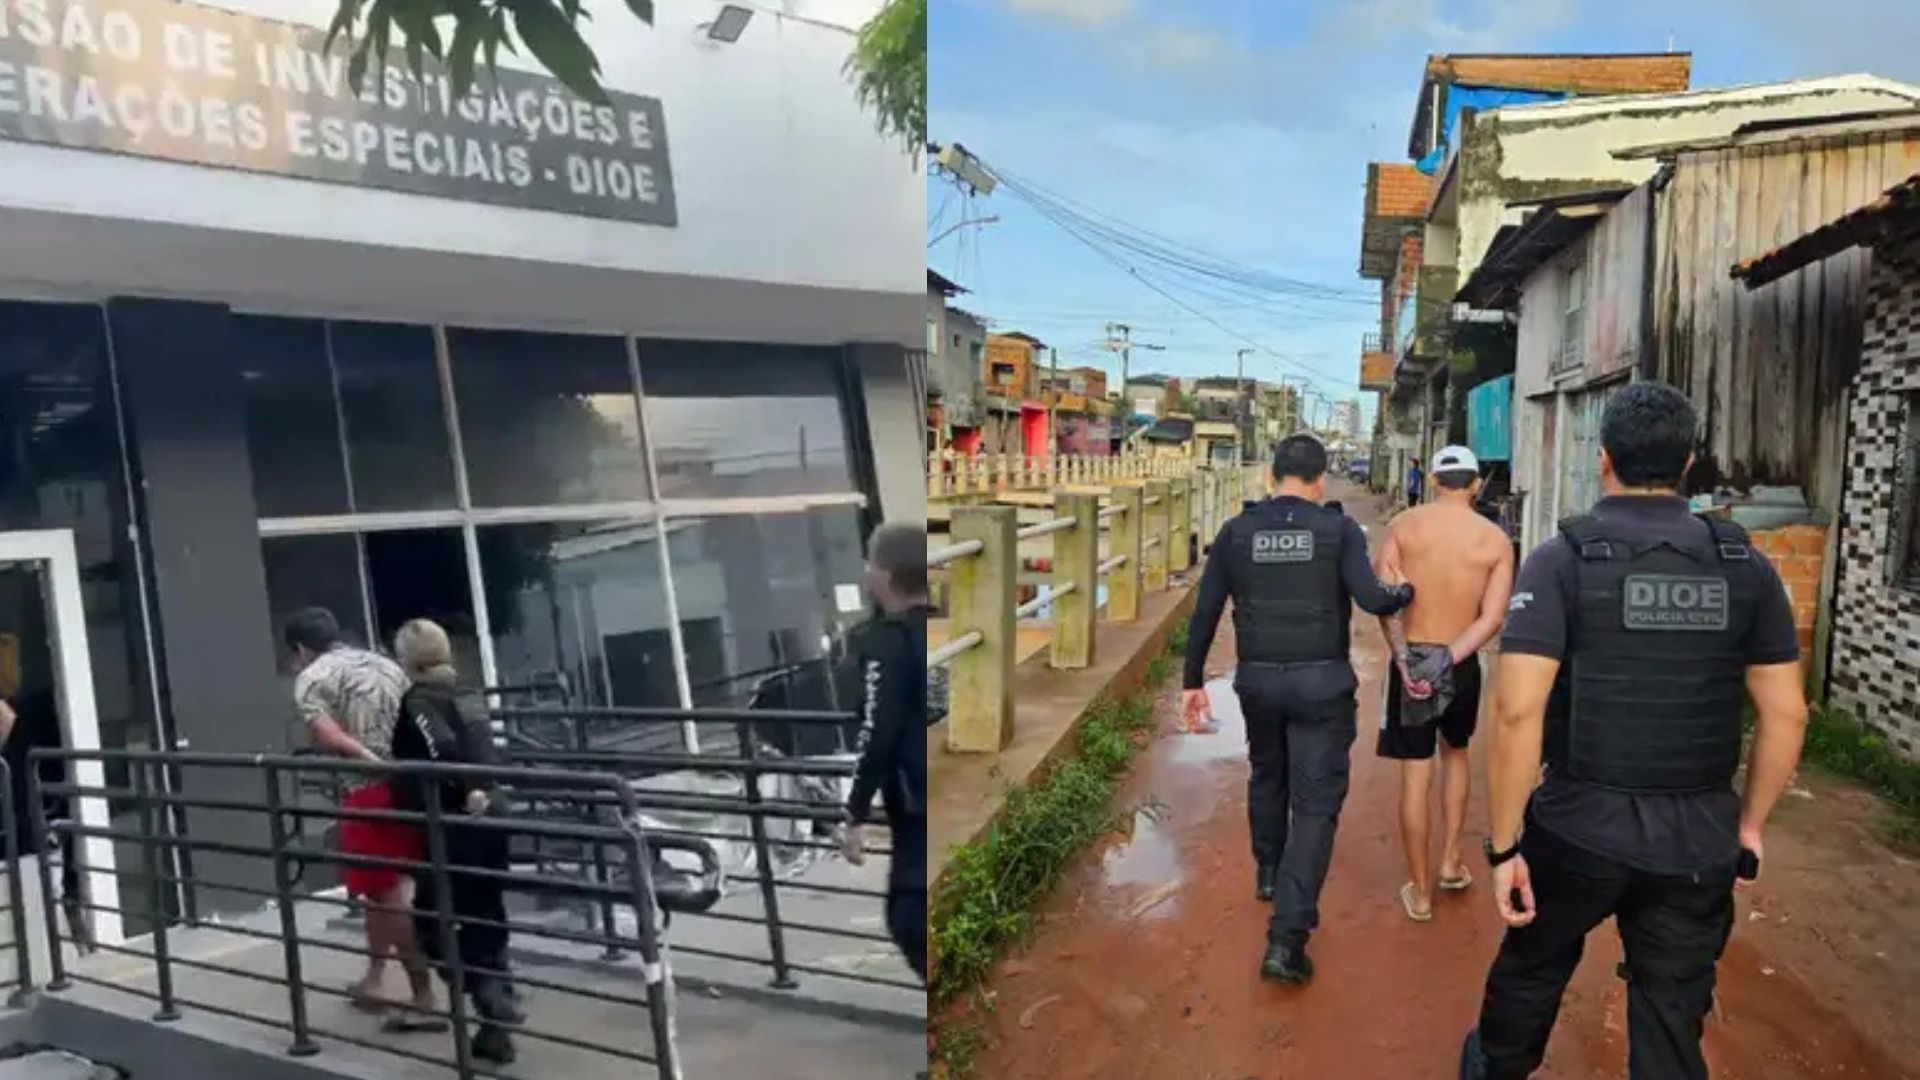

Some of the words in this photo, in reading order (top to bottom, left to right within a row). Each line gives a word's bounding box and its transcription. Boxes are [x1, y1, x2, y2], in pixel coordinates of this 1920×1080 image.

[163, 23, 236, 79] DE
[629, 110, 654, 150] E
[285, 110, 533, 188] ESPECIAIS
[566, 154, 661, 203] DIOE
[1255, 534, 1309, 550] DIOE
[1631, 582, 1722, 609] DIOE
